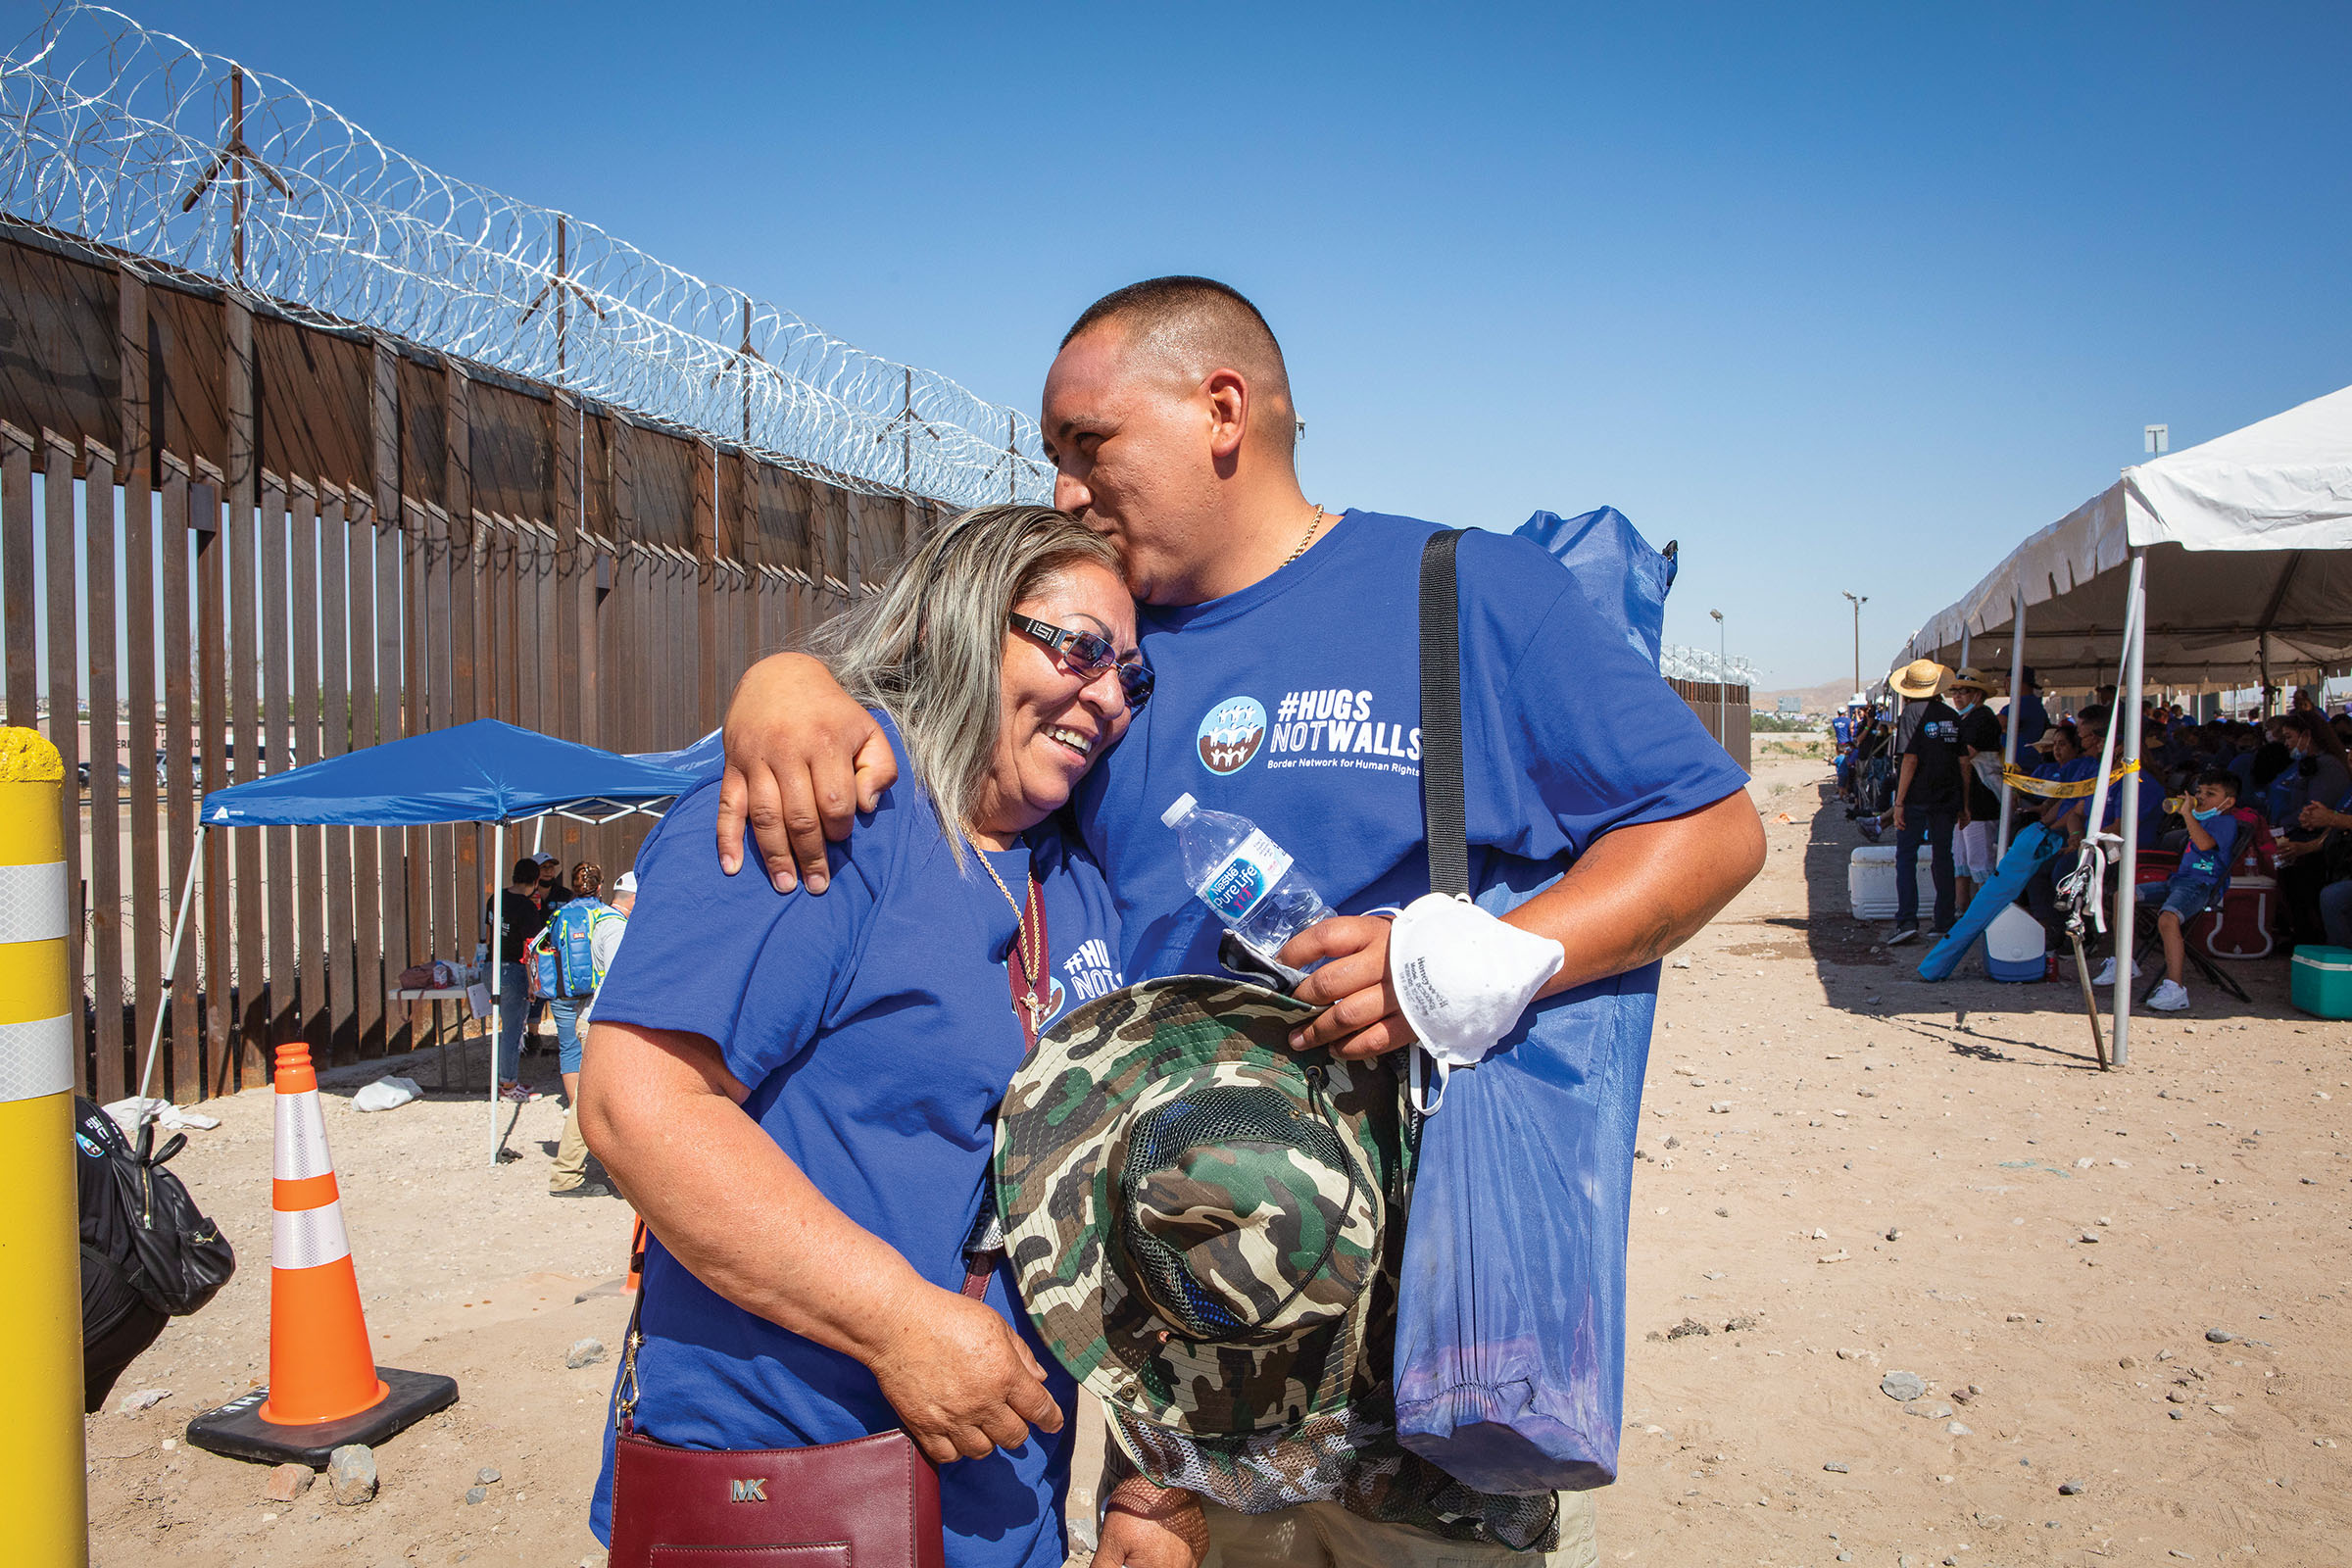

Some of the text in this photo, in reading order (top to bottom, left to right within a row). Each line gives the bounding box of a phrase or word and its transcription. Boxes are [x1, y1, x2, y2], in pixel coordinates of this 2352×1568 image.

[1277, 689, 1373, 721] #HUGS
[1267, 759, 1420, 777] Border Network for Human Rights
[1213, 885, 1240, 908] Pure
[1235, 866, 1257, 888] Life
[1063, 939, 1110, 975] #HU
[1071, 969, 1122, 1000] NOT
[1417, 956, 1448, 1008] Honeywell
[732, 1479, 767, 1501] MK
